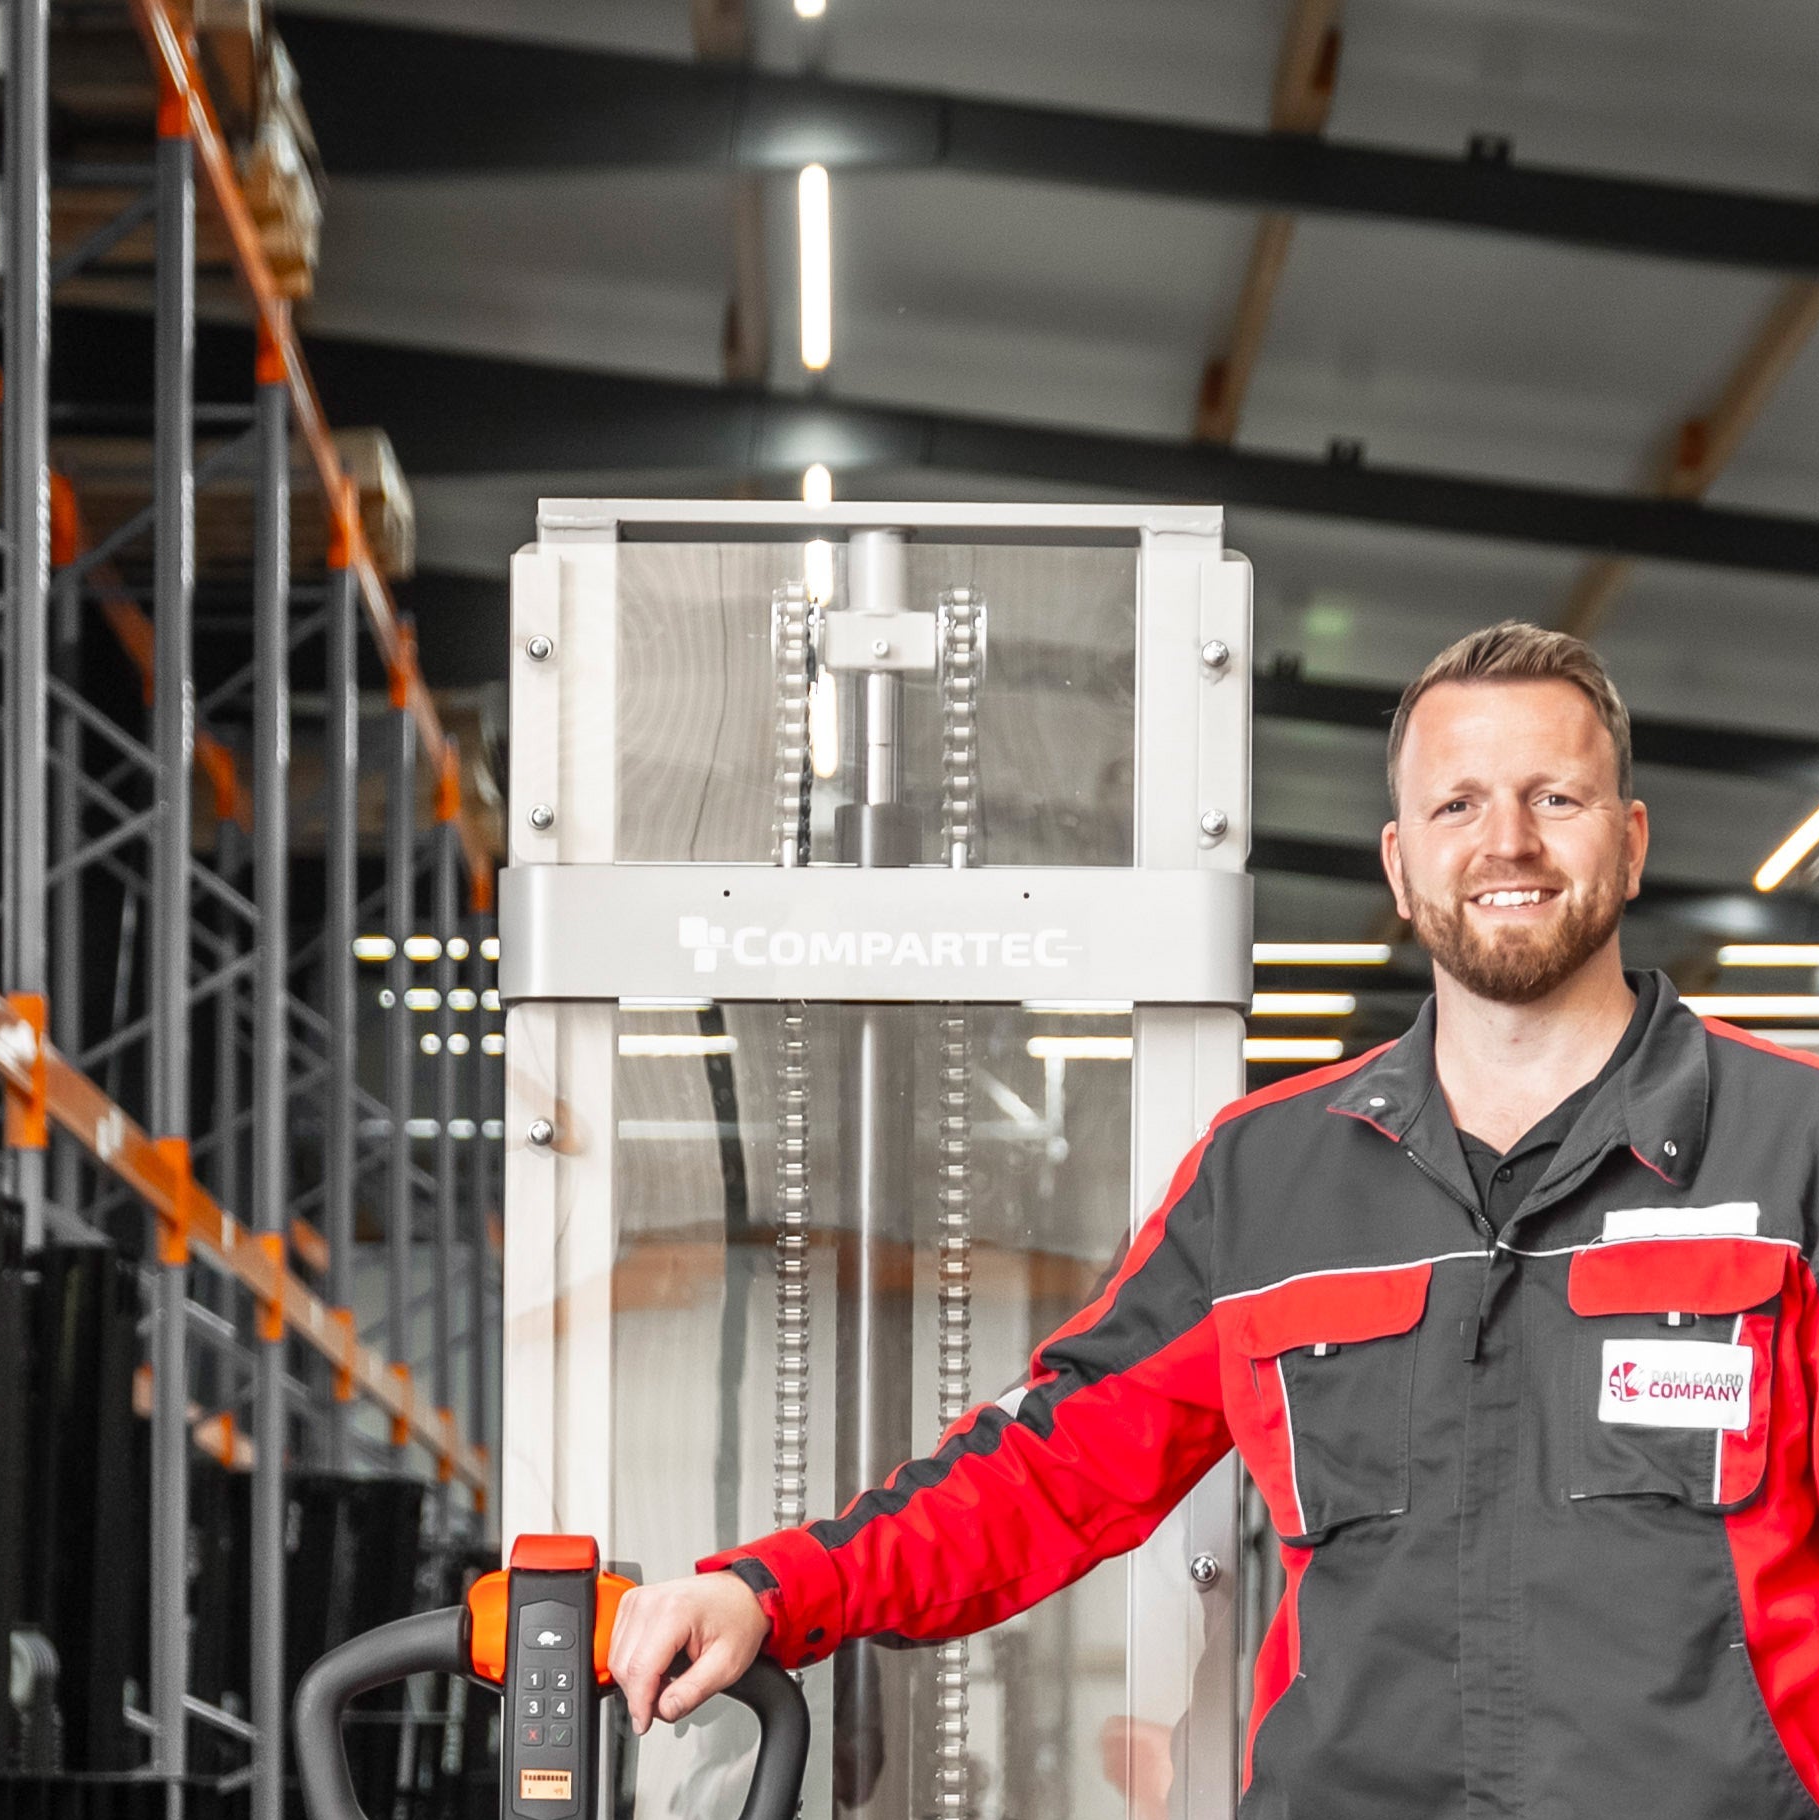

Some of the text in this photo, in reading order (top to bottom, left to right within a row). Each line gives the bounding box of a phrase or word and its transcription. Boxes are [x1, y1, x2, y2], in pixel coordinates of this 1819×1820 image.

[731, 926, 1071, 968] COMPARTEC
[1648, 1382, 1742, 1402] COMPANY
[530, 1673, 567, 1687] 1 2
[529, 1701, 566, 1715] 3 4
